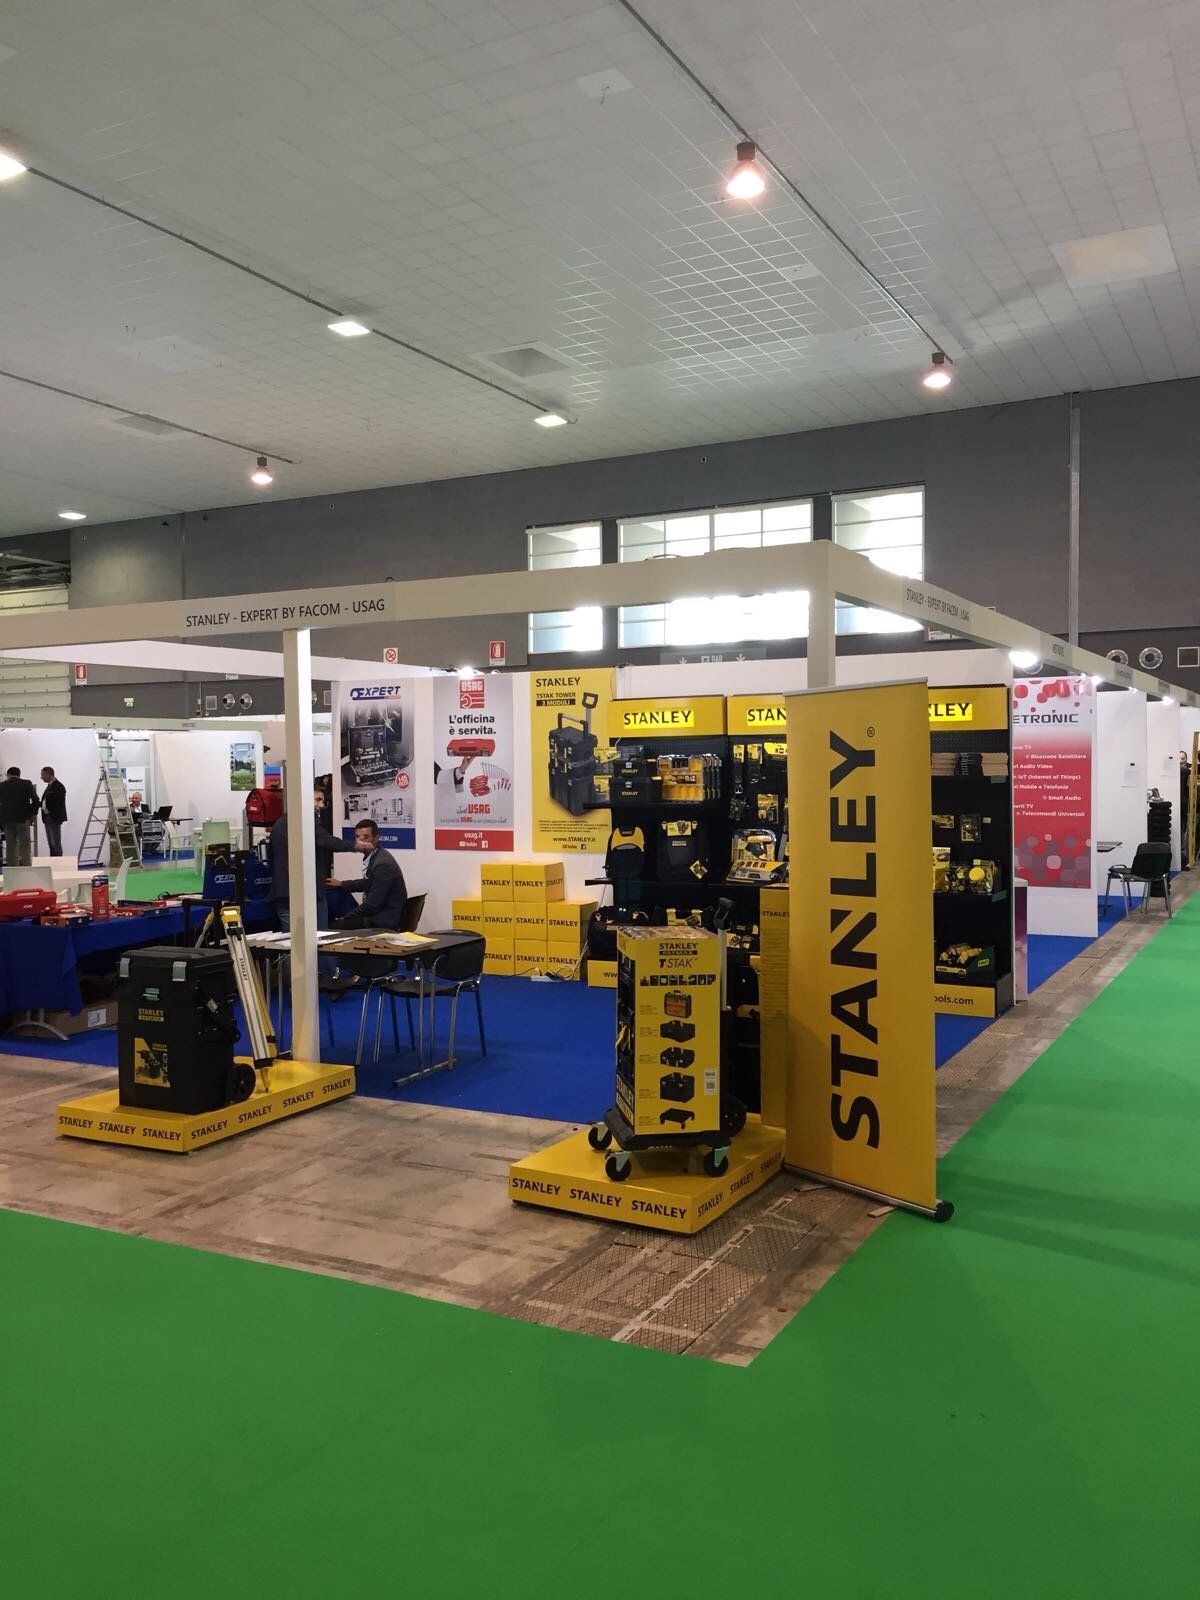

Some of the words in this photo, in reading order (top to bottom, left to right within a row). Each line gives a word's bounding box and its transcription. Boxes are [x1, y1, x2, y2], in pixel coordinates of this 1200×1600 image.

[186, 612, 230, 628] STANLEY
[240, 608, 278, 622] EXPERT
[282, 606, 296, 619] BY
[299, 603, 340, 618] FACOM
[352, 599, 385, 613] USAG
[461, 680, 484, 691] USAG
[536, 677, 580, 688] STANLEY
[928, 702, 970, 717] LEY
[448, 714, 495, 724] L'officina
[624, 710, 692, 725] STANLEY
[449, 726, 455, 735] è
[458, 726, 496, 735] servita.
[468, 804, 490, 814] USAG
[549, 919, 578, 927] STANLEY
[830, 730, 880, 1150] STANLEY
[484, 952, 512, 961] STANLEY
[516, 954, 545, 962] STANLEY
[548, 956, 578, 964] STANLEY
[138, 1008, 164, 1016] STANLEY
[191, 1119, 228, 1140] STANLEY
[238, 1104, 272, 1123] STANLEY
[283, 1090, 314, 1108] STANLEY
[323, 1077, 352, 1094] STANLEY
[59, 1115, 93, 1129] STANLEY
[98, 1121, 136, 1135] STANLEY
[142, 1128, 182, 1141] STANLEY
[697, 1192, 724, 1218] STANLEY
[730, 1171, 754, 1196] STANLEY
[760, 1152, 782, 1174] STANLEY
[512, 1178, 561, 1196] STANLEY
[570, 1188, 622, 1208] STANLEY
[632, 1200, 687, 1220] STANLEY
